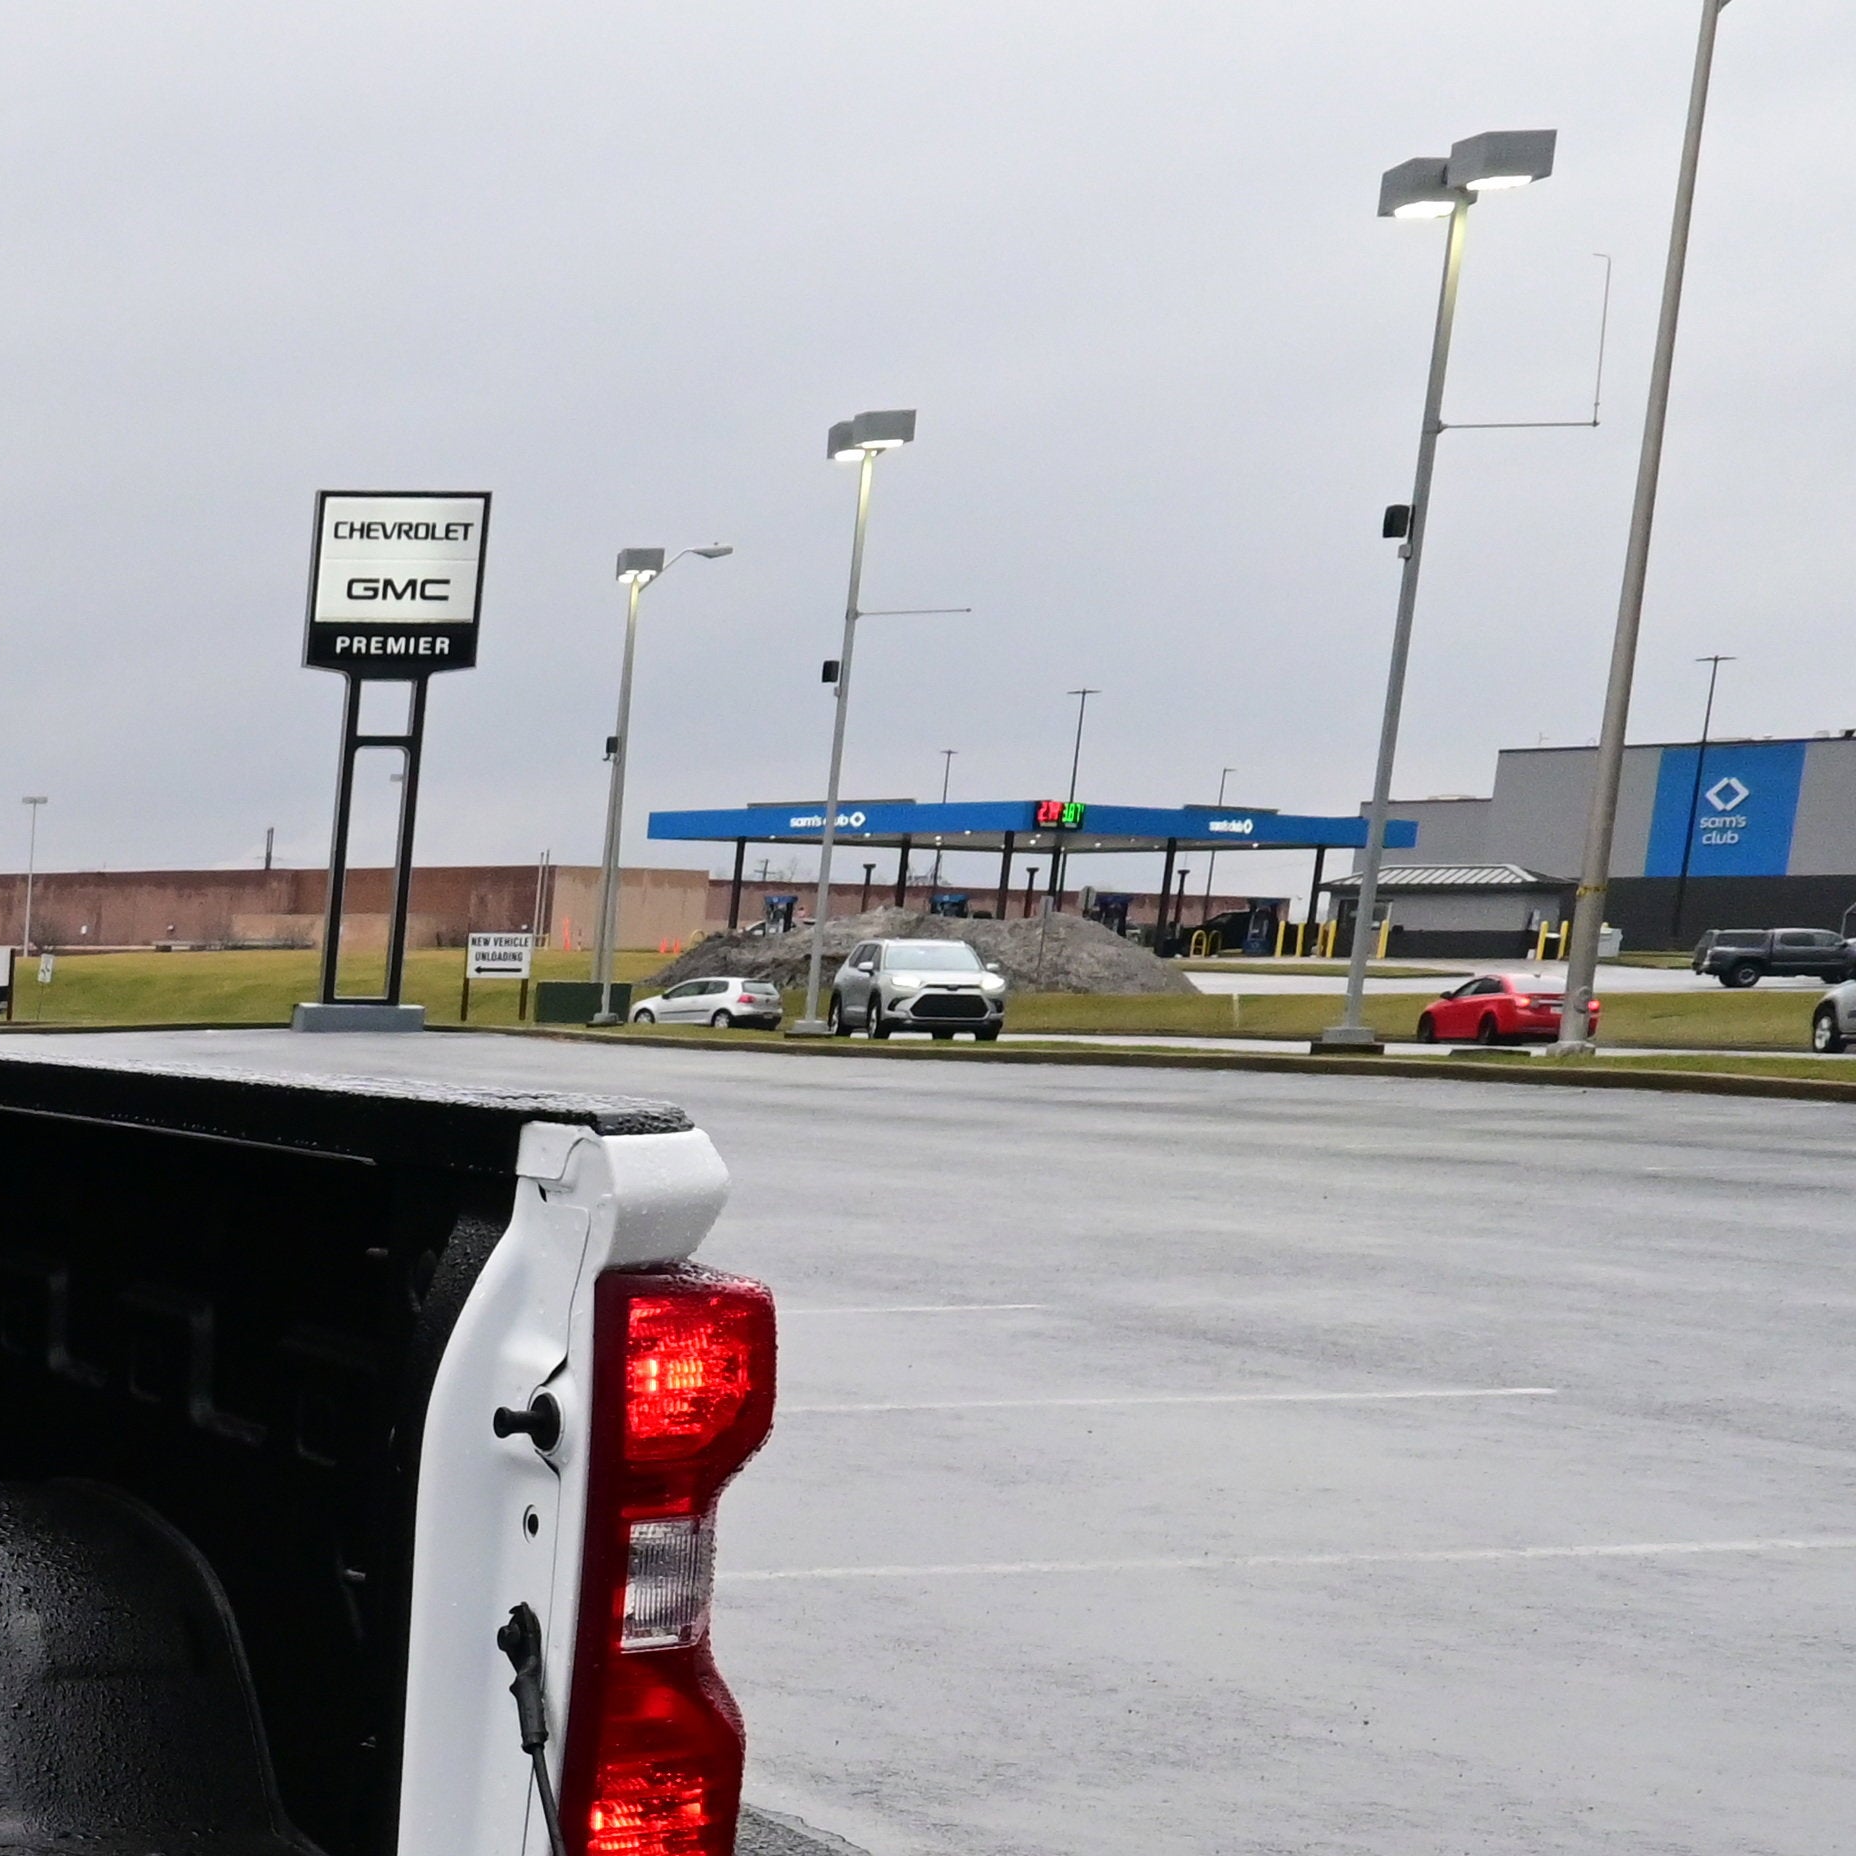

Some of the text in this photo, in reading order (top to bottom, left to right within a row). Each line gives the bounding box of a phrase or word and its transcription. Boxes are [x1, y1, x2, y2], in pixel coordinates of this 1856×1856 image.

[333, 520, 474, 541] CHEVROLET
[346, 577, 451, 601] GMC
[335, 635, 451, 655] PREMIER
[1699, 815, 1747, 829] sam's
[1701, 830, 1739, 845] club
[471, 936, 529, 948] NEW VEHICLE
[474, 951, 523, 962] UNLOADING
